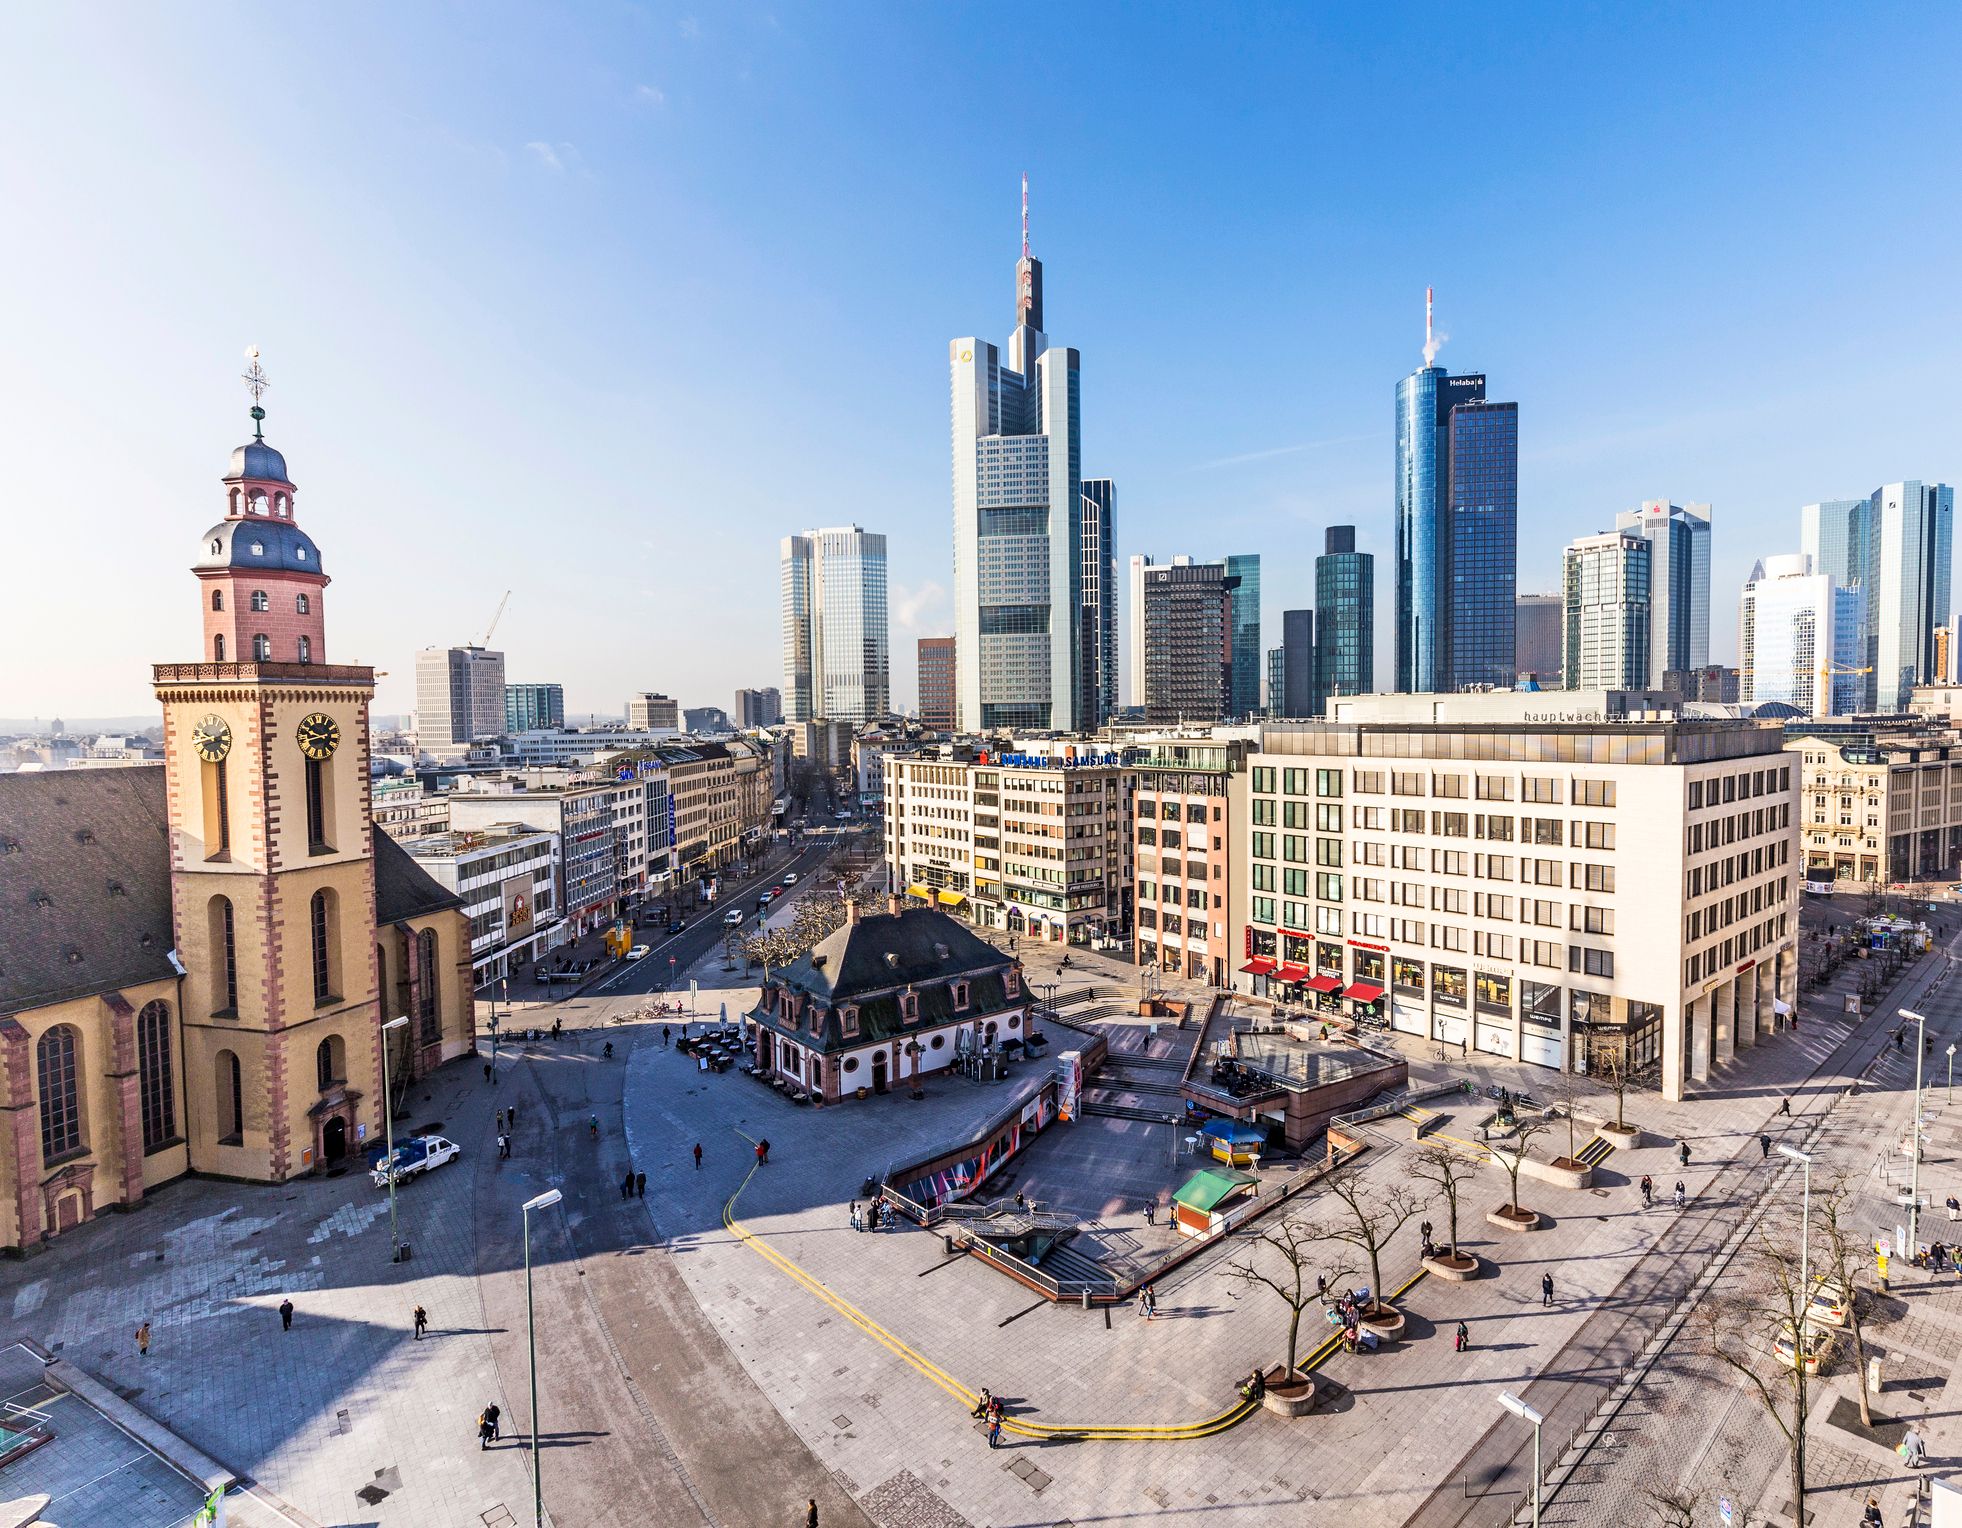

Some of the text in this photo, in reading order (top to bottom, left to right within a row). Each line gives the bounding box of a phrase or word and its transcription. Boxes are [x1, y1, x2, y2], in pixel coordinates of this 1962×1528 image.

[1450, 379, 1475, 387] Helaba
[1524, 711, 1611, 723] hauptwache
[1001, 752, 1047, 767] SAMSUNG
[1065, 752, 1119, 767] SAMSUNG
[1347, 939, 1391, 952] MAREDO
